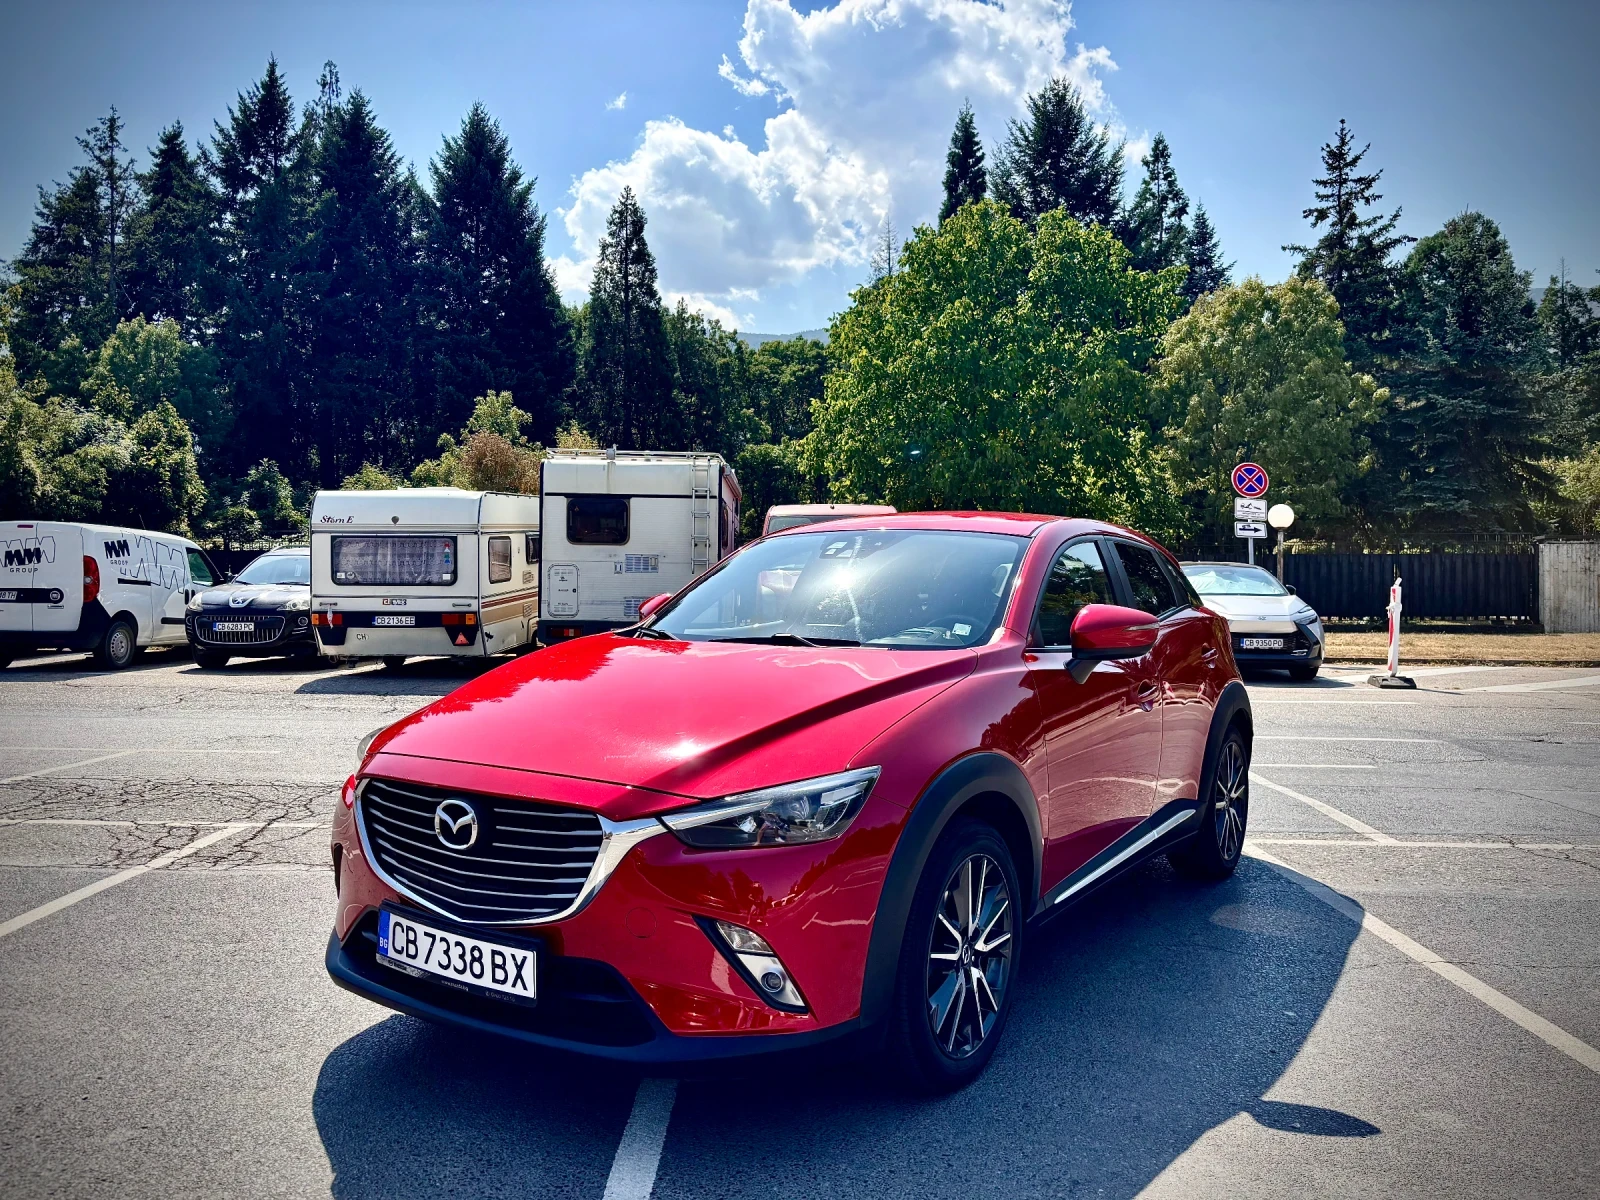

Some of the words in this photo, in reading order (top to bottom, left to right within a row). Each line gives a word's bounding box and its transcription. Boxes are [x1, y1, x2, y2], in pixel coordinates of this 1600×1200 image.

[376, 616, 386, 625] CB
[386, 616, 404, 625] 2136
[404, 616, 415, 625] EE
[1255, 639, 1273, 647] 9350
[379, 936, 388, 949] BG
[392, 921, 419, 960] CB
[423, 931, 485, 980] 7338
[490, 949, 528, 992] BX
